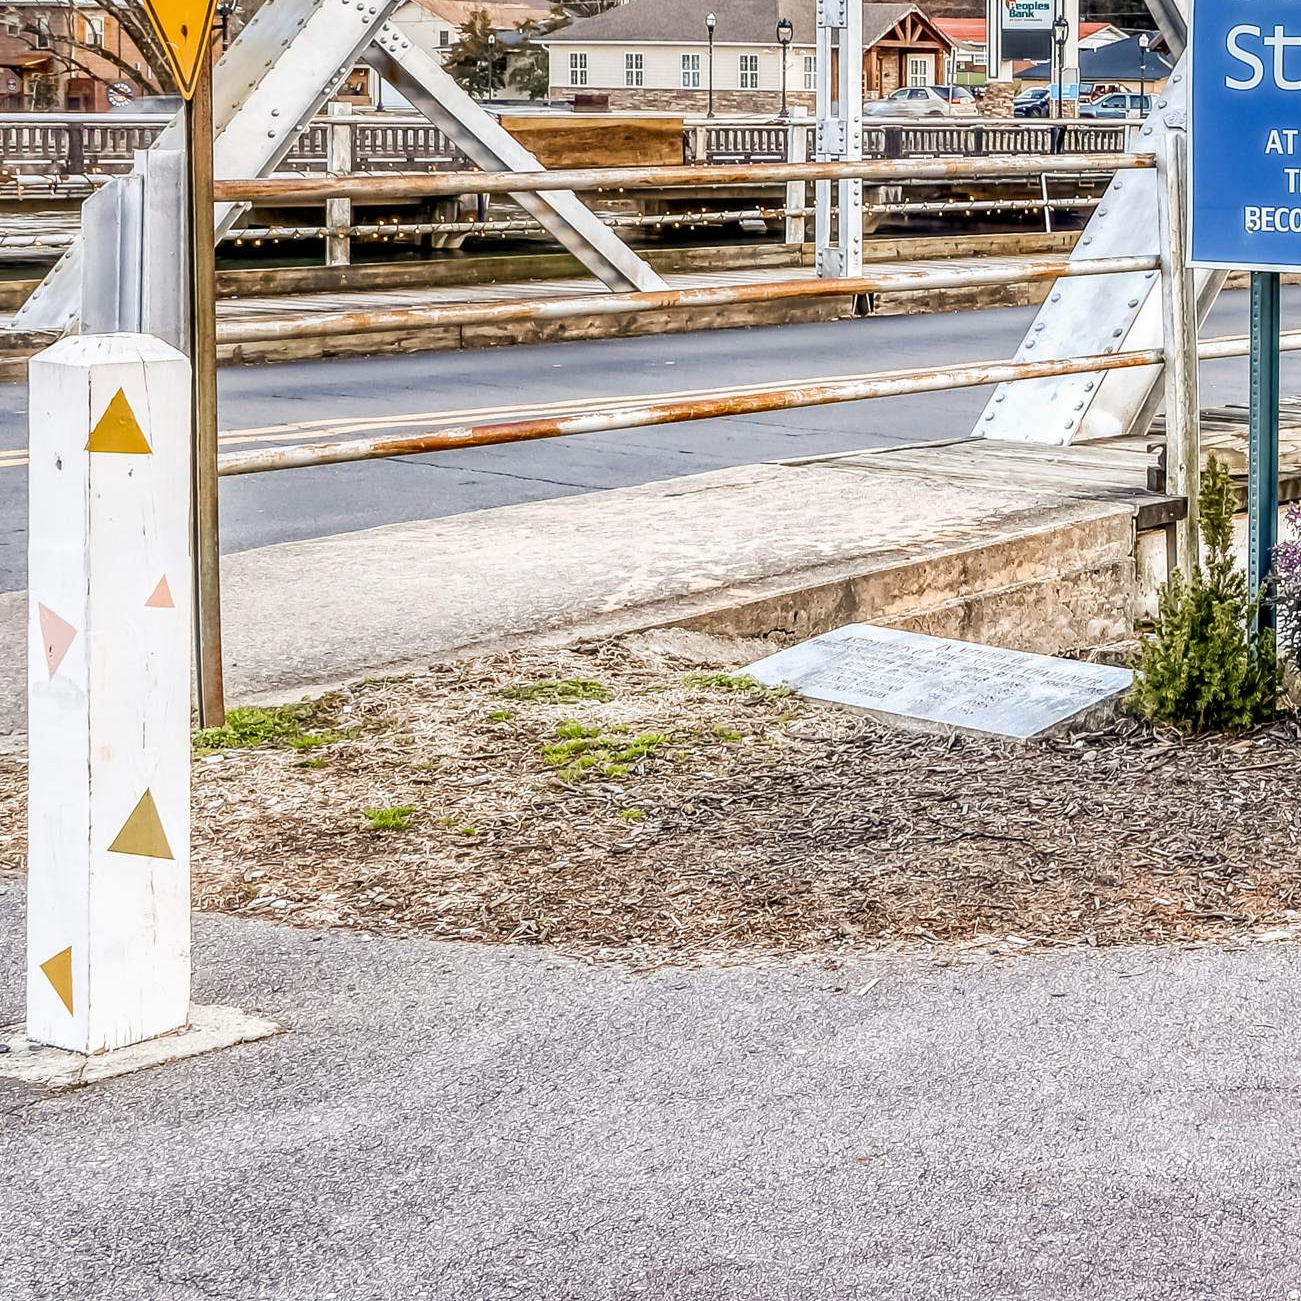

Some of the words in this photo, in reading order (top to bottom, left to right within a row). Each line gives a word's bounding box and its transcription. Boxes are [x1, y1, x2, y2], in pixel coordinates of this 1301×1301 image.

[1008, 0, 1050, 11] Peoples
[1009, 9, 1035, 18] Bank
[1264, 129, 1299, 155] AT
